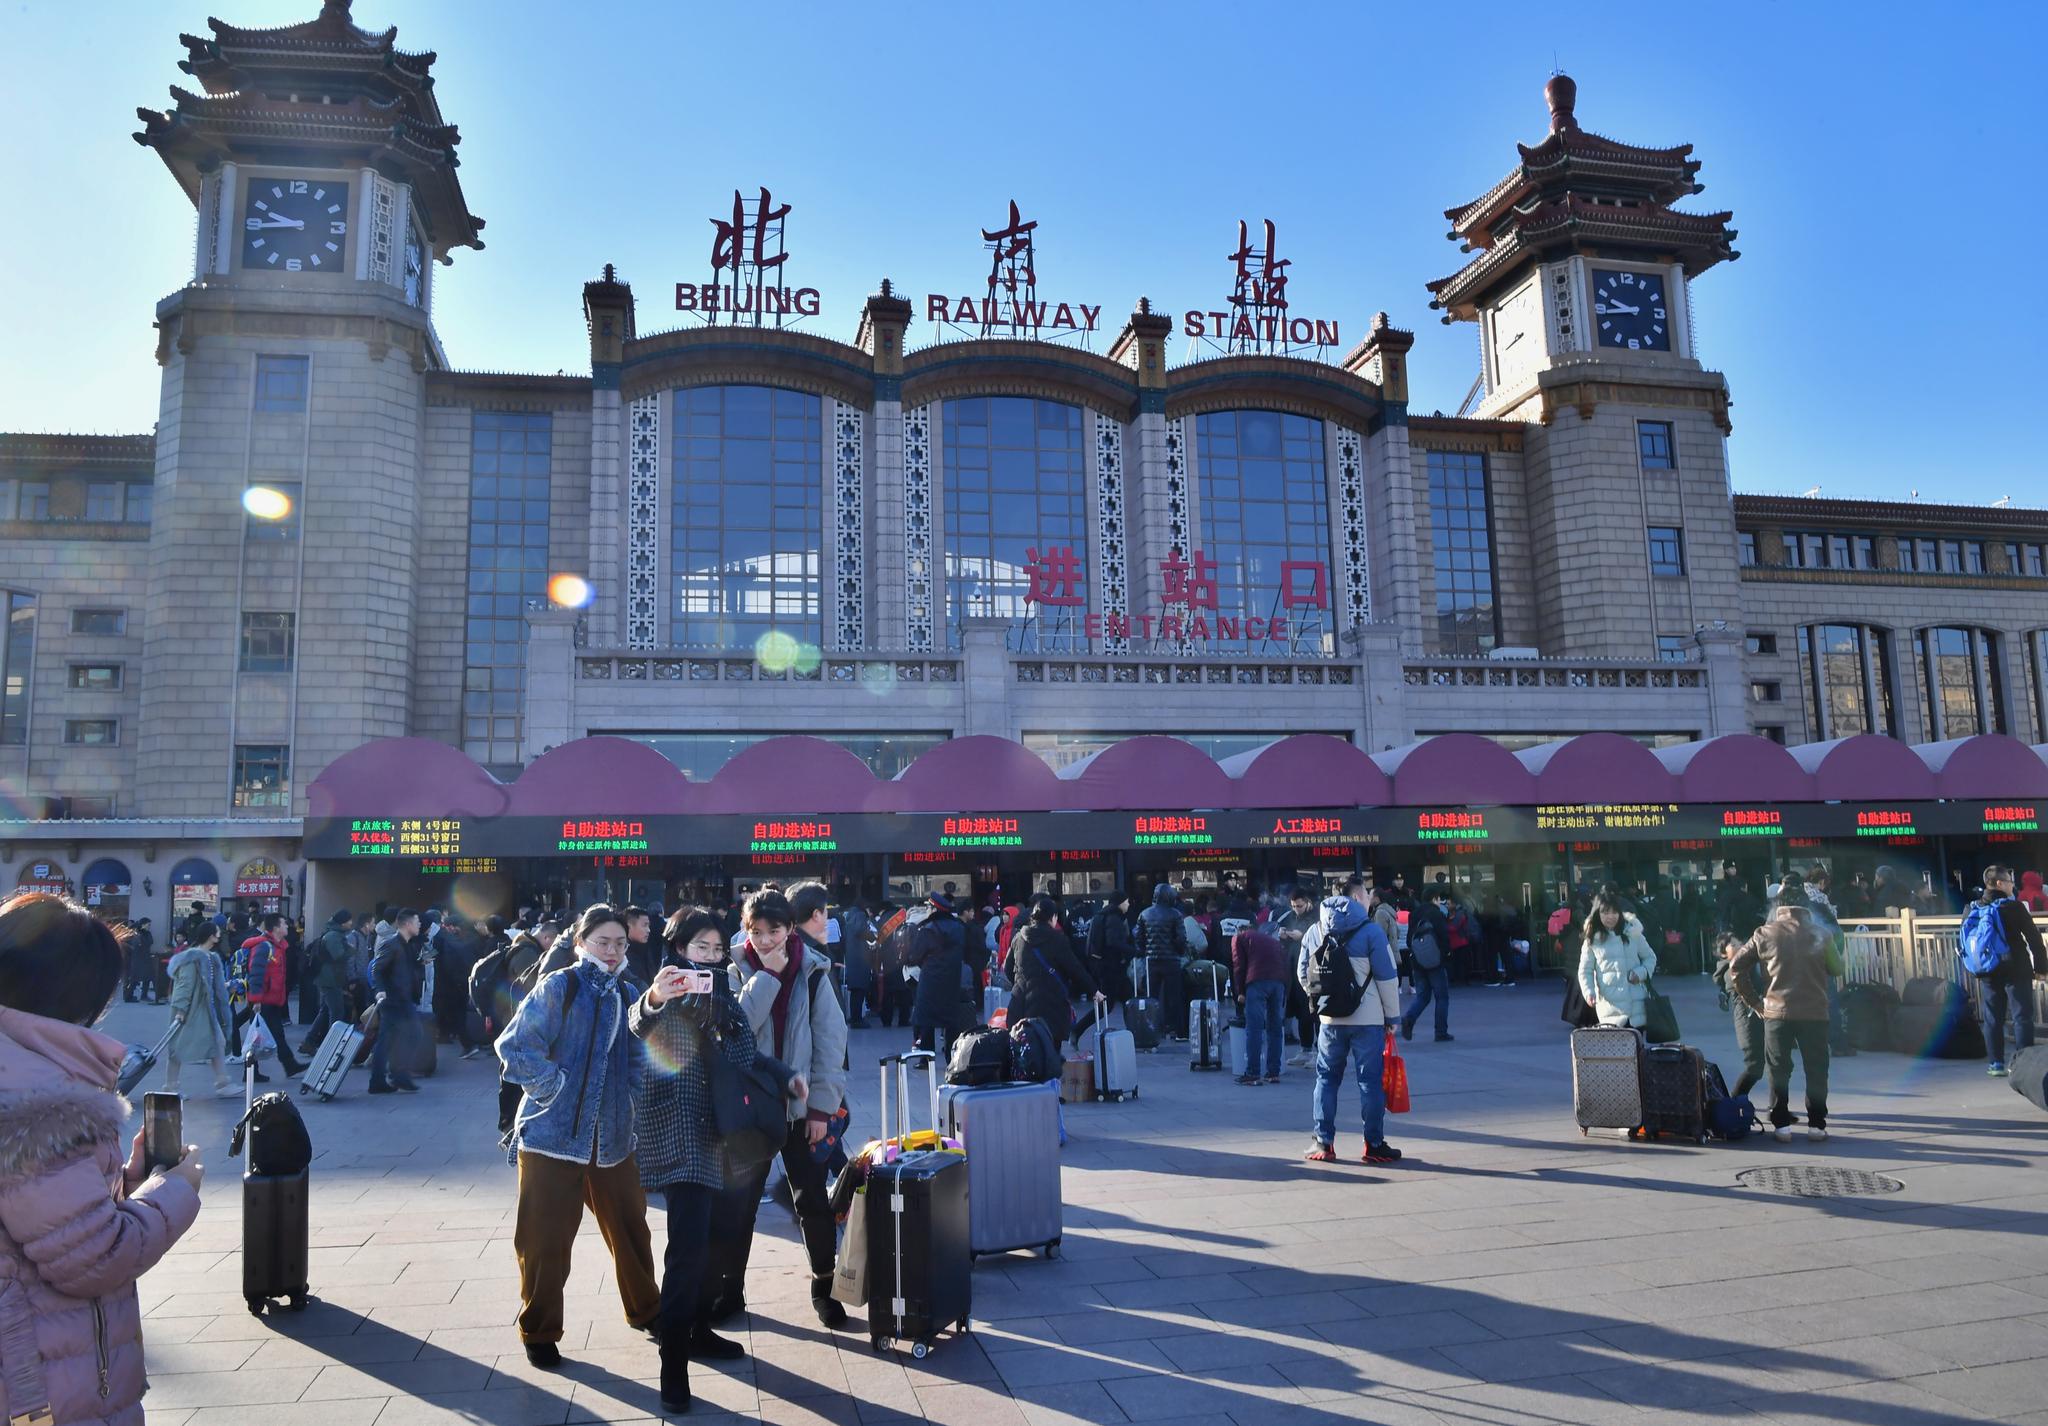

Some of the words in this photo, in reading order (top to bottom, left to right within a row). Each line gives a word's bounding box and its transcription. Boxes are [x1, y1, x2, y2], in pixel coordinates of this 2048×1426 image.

[290, 181, 308, 194] 12
[330, 222, 346, 234] 3
[286, 258, 302, 272] 6
[1620, 273, 1634, 285] 12
[675, 283, 820, 315] BEIJING
[927, 294, 1101, 331] RAILWAY
[1184, 310, 1339, 345] STATION
[1595, 303, 1607, 315] 9
[1653, 307, 1666, 320] 3
[1628, 338, 1640, 350] 6
[1023, 547, 1327, 610] 进站口
[1084, 613, 1288, 641] ENTRANCE
[1418, 812, 1484, 829] 自助进站口
[1723, 810, 1781, 825] 自助进站口
[1857, 811, 1912, 826] 自助进站口
[1984, 807, 2035, 821] 自助进站口
[563, 821, 644, 838] 自助进站口
[754, 822, 832, 839] 自助进站口
[944, 818, 1018, 834] 自助进站口
[1135, 816, 1206, 833] 自助进站口
[1273, 818, 1342, 834] 人工进站口
[238, 882, 279, 893] 北京特产
